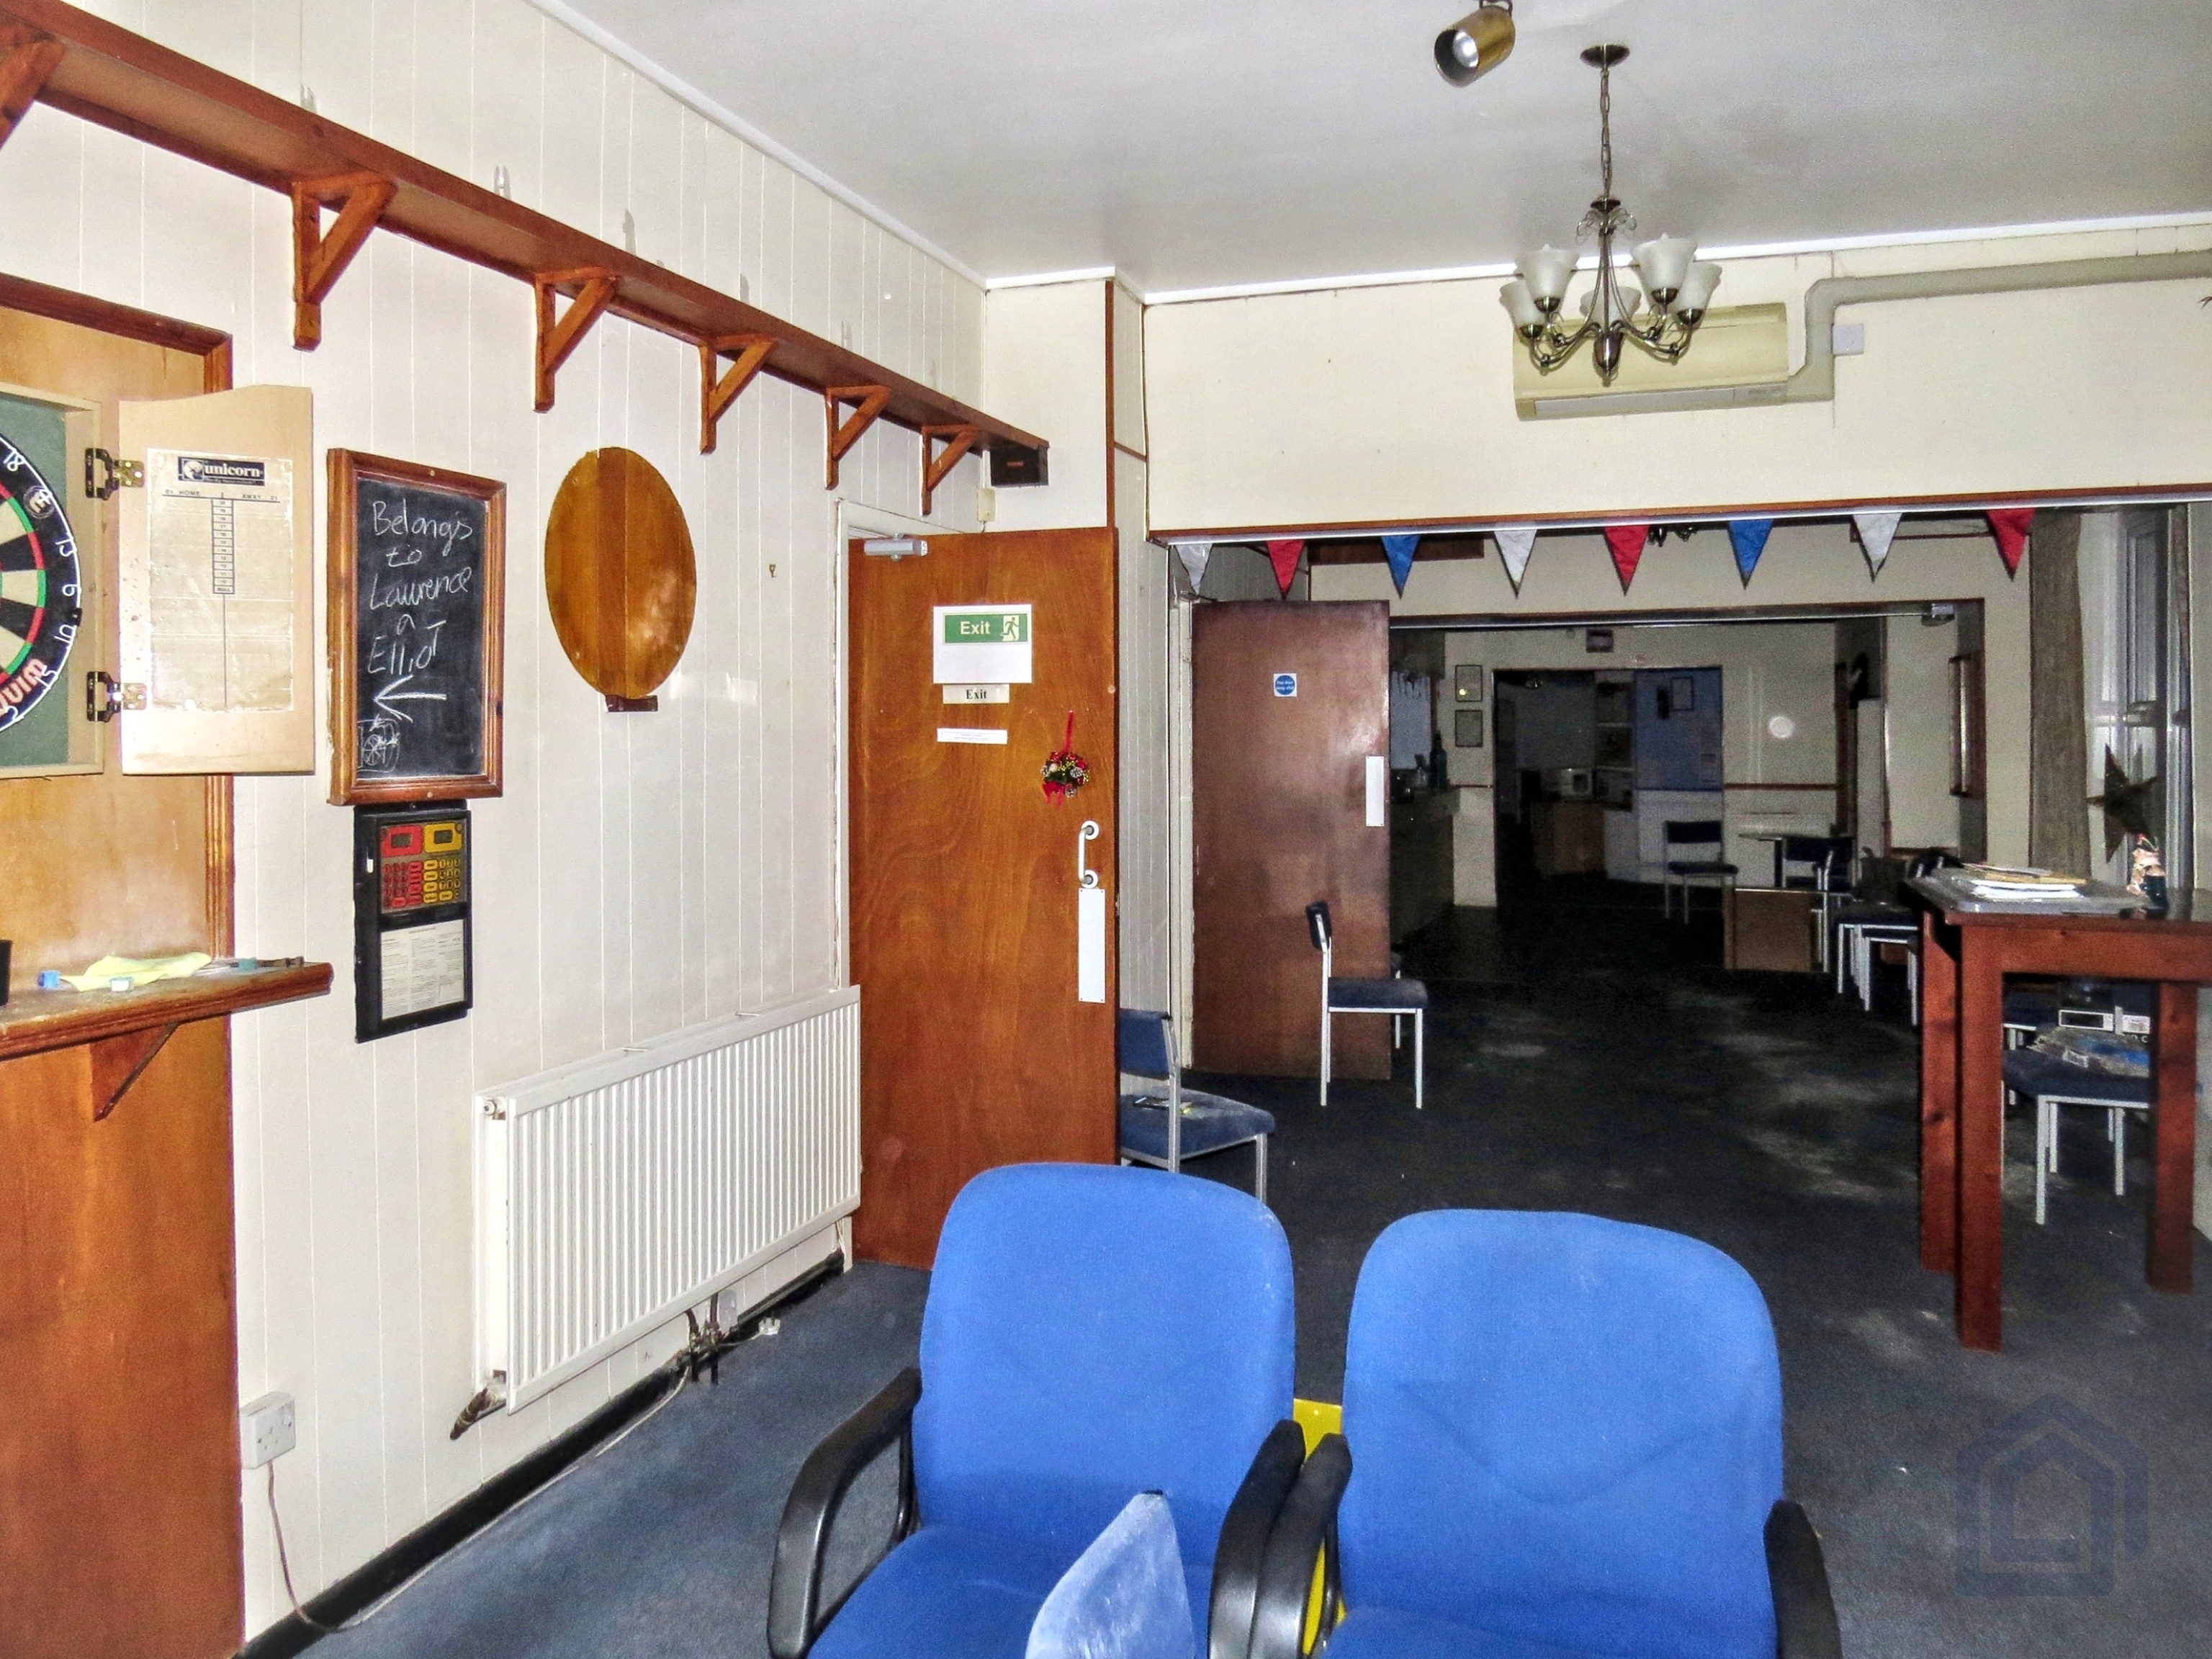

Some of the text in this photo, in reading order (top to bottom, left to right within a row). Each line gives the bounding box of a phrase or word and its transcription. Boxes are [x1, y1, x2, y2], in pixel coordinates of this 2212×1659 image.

[204, 463, 260, 477] unicorn
[385, 547, 423, 567] to
[960, 620, 991, 635] Exit
[966, 689, 988, 699] Exit
